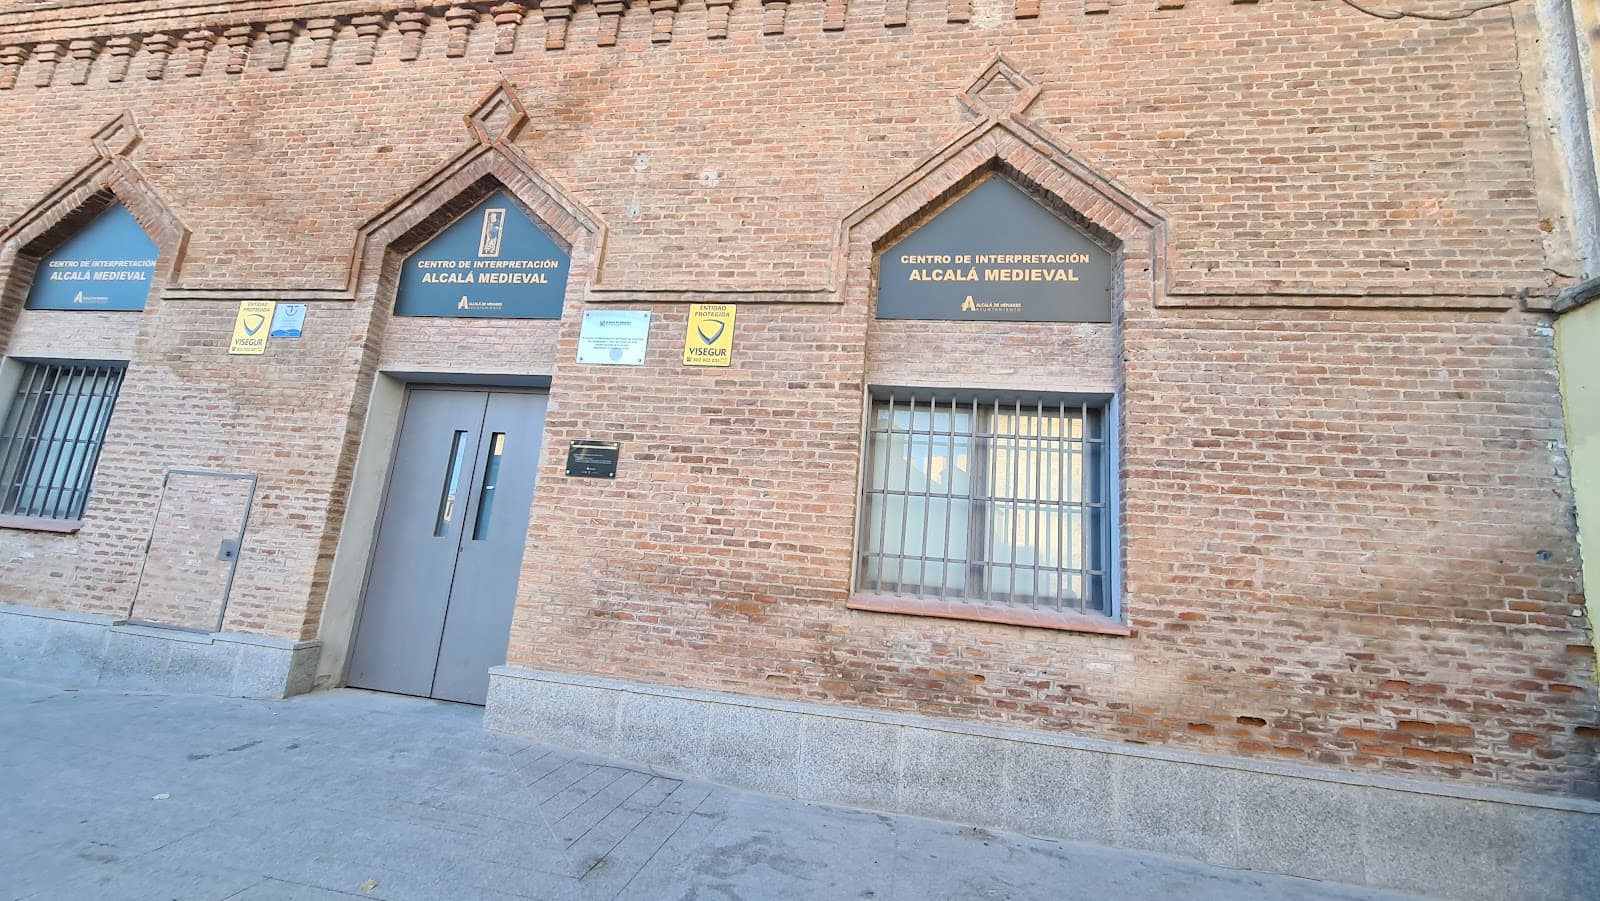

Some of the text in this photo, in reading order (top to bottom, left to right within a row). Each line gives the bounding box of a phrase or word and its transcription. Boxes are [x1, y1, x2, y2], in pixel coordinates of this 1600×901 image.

[49, 258, 157, 268] CENTRO DE INTERPRETACIÓN
[417, 258, 559, 269] CENTRO DE INTERPRETACIÓN
[901, 253, 1090, 264] CENTRO DE INTERPRETACIÓN
[50, 269, 147, 281] ALCALÁ MEDIEVAL
[422, 271, 548, 284] ALCALÁ MEDIEVAL
[908, 266, 1080, 281] ALCALÁ MEDIEVAL
[235, 338, 263, 346] VISEGUR
[689, 347, 727, 357] VISEGUR
